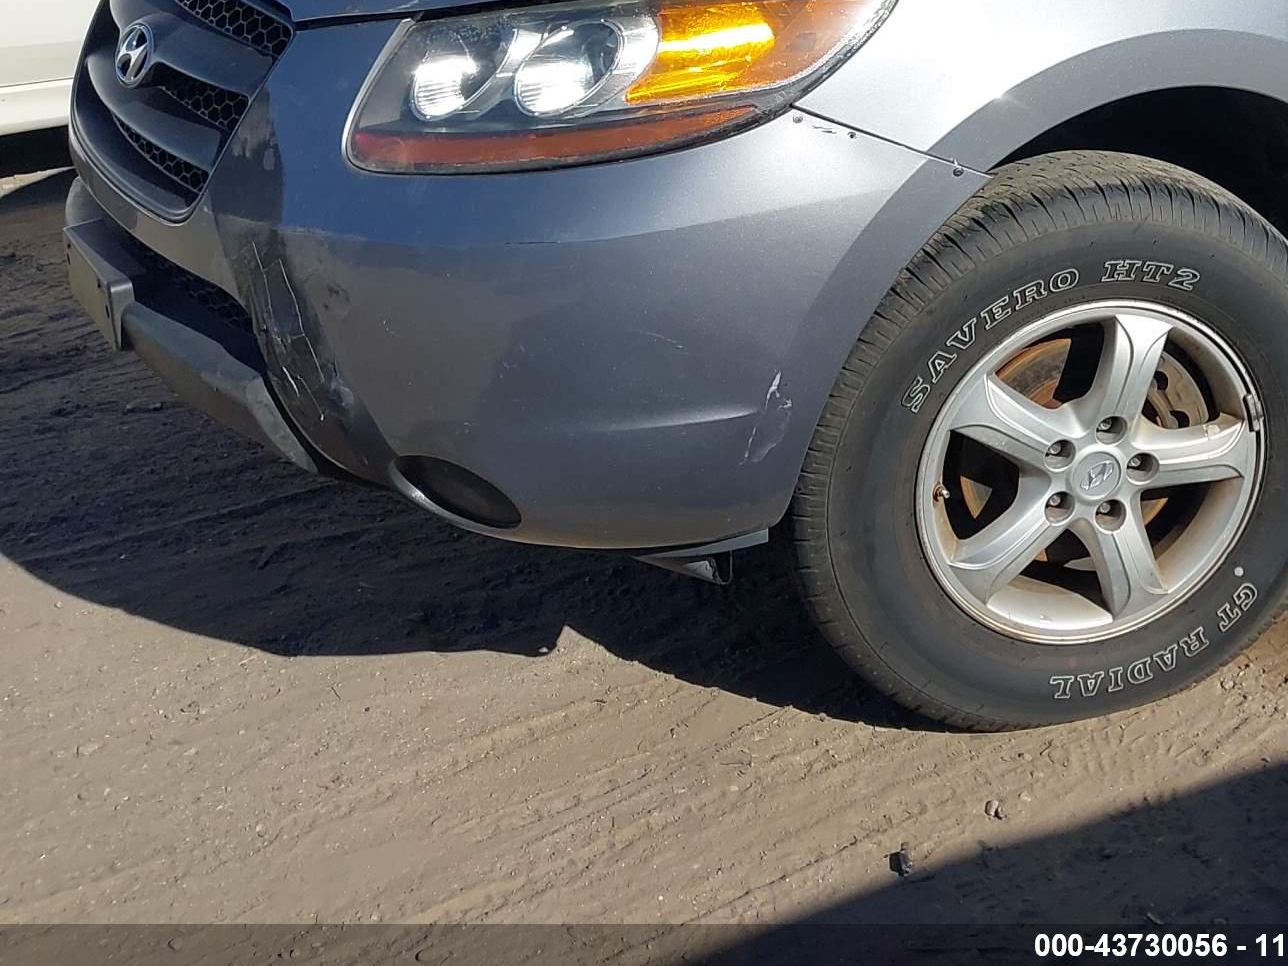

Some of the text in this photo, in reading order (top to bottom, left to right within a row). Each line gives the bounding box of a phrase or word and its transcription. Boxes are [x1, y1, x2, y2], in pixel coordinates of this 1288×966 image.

[901, 260, 1201, 413] SAVERO HT2
[1050, 583, 1258, 699] GT RADIAL
